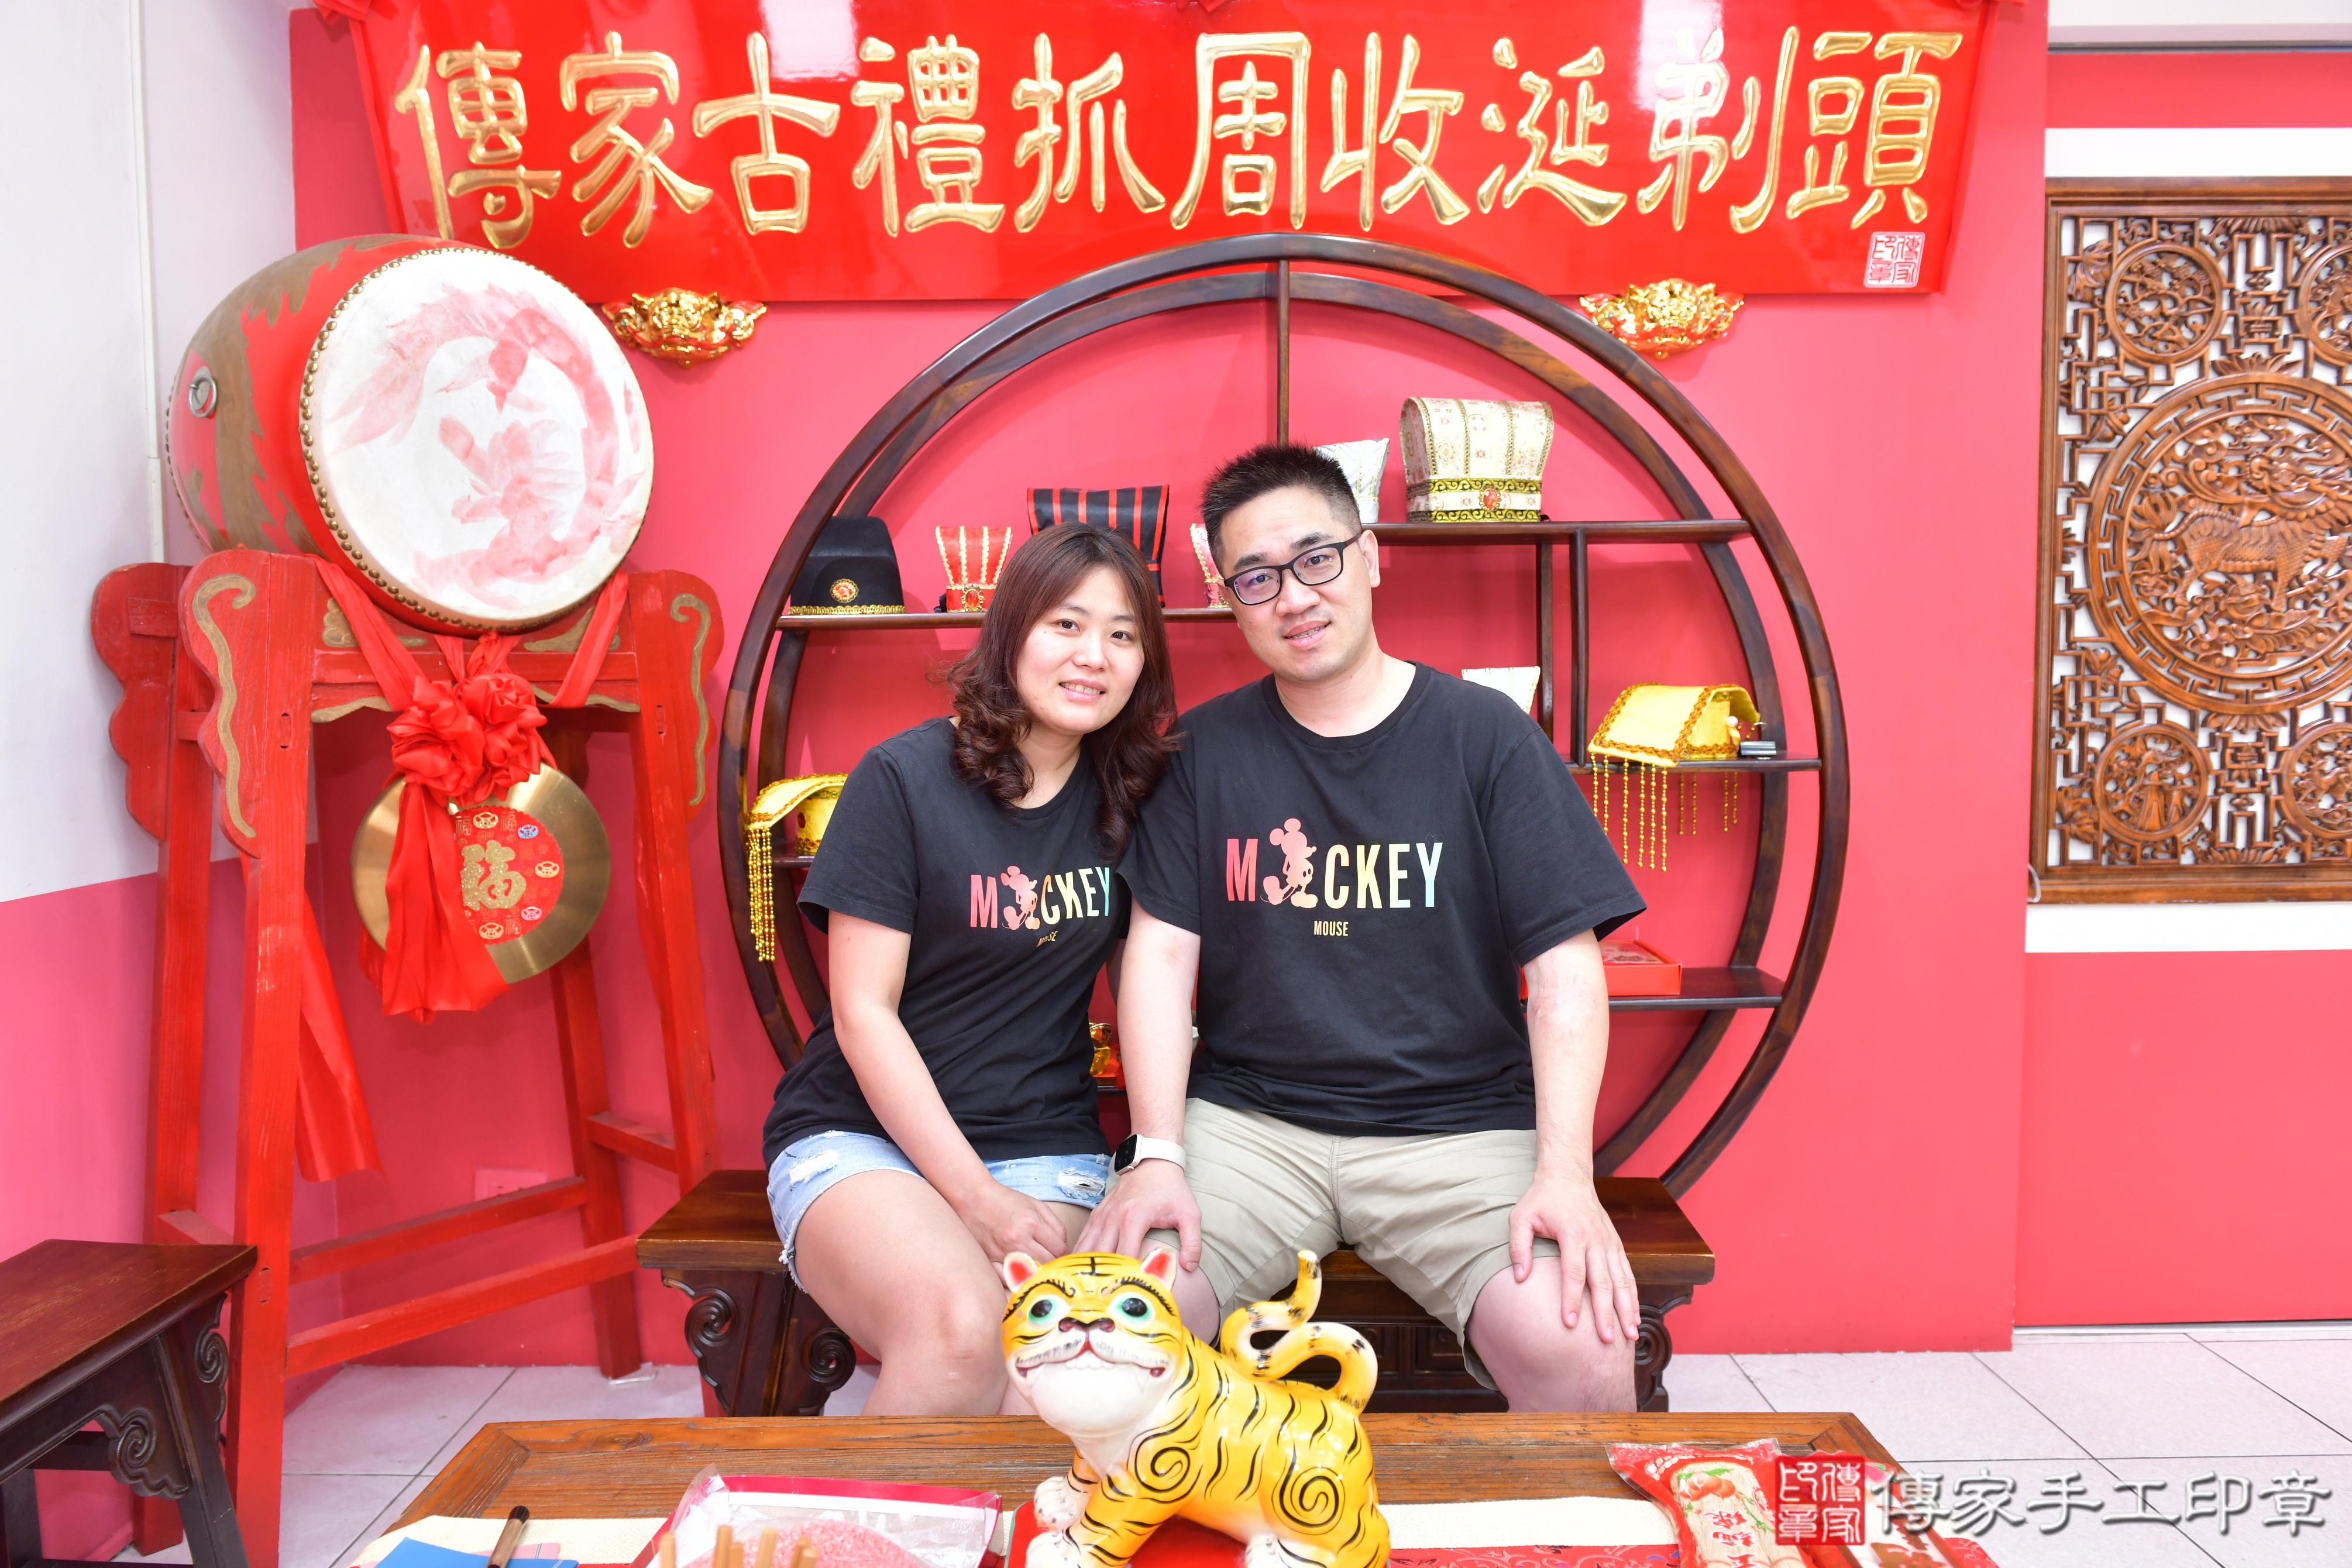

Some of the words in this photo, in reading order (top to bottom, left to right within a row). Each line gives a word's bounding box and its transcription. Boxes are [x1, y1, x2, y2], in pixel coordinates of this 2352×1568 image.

[394, 25, 1963, 249] 傳家古禮抓周收涎剃頭
[970, 866, 1110, 929] MCKEY
[1226, 836, 1443, 909] MCKEY
[1036, 930, 1058, 948] MOSE
[1313, 920, 1349, 937] MOUSE
